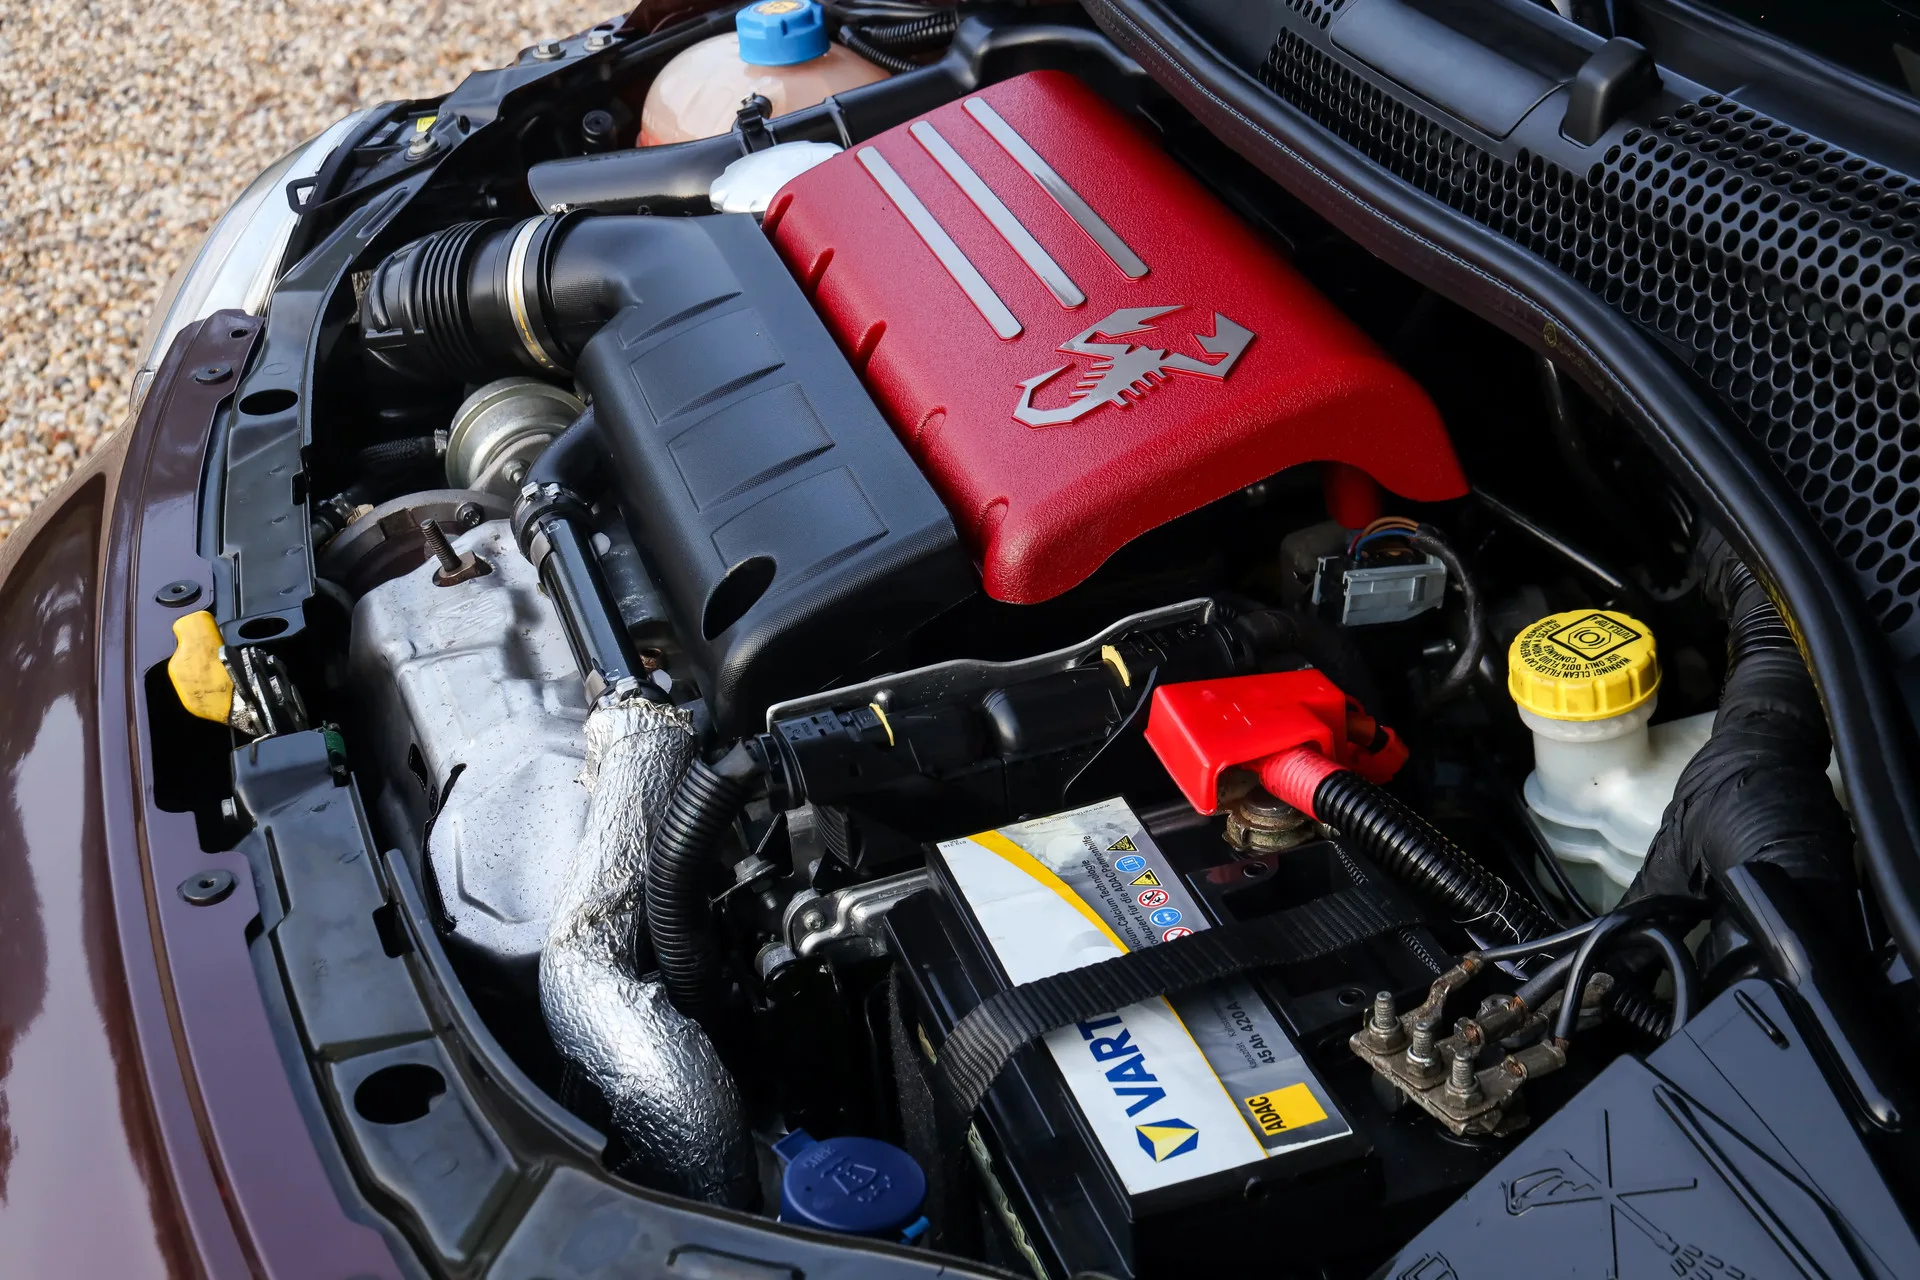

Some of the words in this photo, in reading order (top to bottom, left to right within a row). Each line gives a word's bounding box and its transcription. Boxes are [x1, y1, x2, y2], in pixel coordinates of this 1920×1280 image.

[1595, 619, 1609, 628] TOP
[1609, 623, 1633, 640] TUTELA
[1530, 642, 1542, 657] FROM
[1543, 644, 1577, 663] CONTAINER
[1524, 657, 1539, 667] CAP
[1538, 655, 1559, 669] FLUID
[1585, 660, 1606, 670] ONLY
[1606, 653, 1621, 663] USE
[1535, 664, 1561, 678] FILLER
[1561, 663, 1581, 671] DOT4
[1562, 669, 1591, 679] CLEAN
[1594, 658, 1632, 677] WARNING!
[1082, 835, 1112, 875] Pannenhilfe
[1081, 859, 1109, 899] Technologie
[1105, 870, 1126, 894] ADAC
[1120, 892, 1133, 906] die
[1128, 904, 1139, 917] für
[1107, 896, 1142, 950] alcium-Calcium
[1134, 914, 1159, 944] oduziert
[1075, 1016, 1166, 1118] VART
[1248, 1096, 1286, 1131] ADAC
